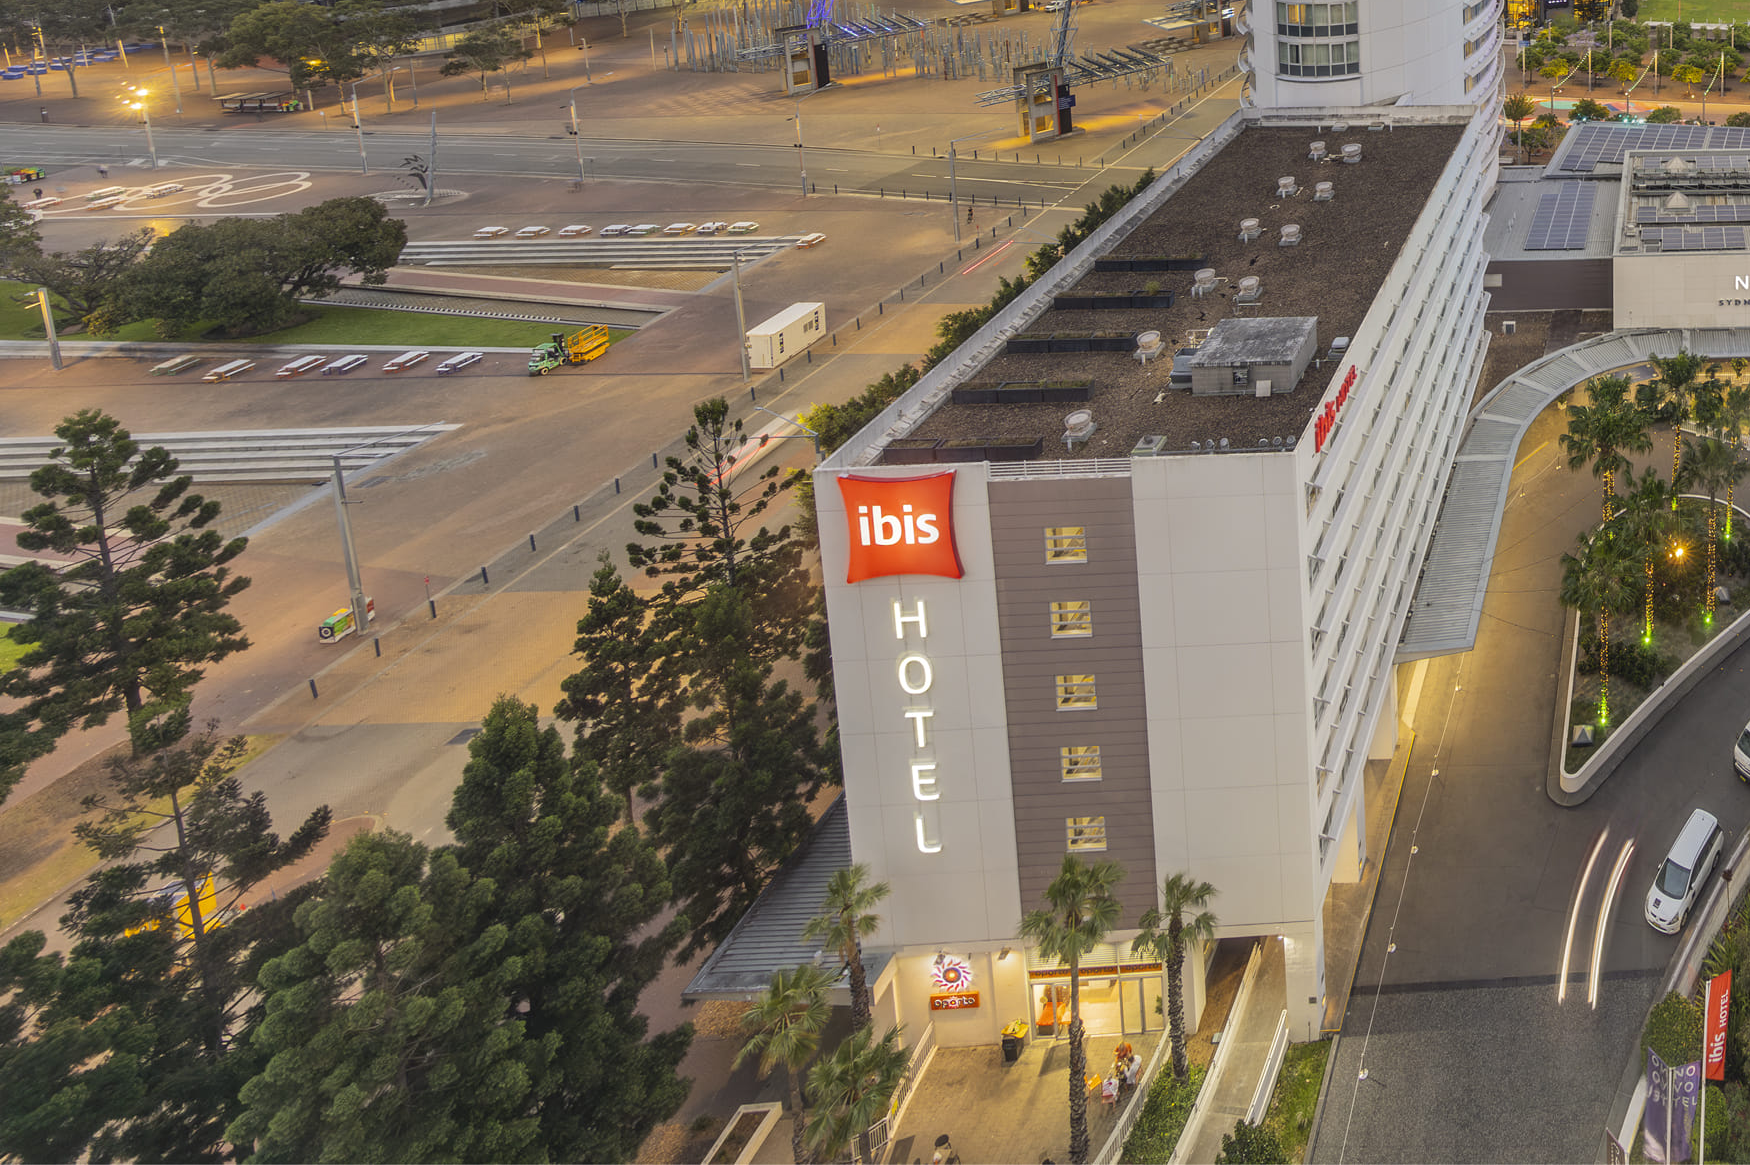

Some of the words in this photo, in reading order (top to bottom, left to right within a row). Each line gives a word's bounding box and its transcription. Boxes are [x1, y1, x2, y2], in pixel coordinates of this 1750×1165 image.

[1315, 401, 1336, 453] ibis
[858, 504, 940, 546] ibis
[892, 598, 943, 854] HOTEL
[934, 996, 975, 1008] oporto
[1708, 1032, 1726, 1063] ibis
[1720, 989, 1729, 1027] HOTEL
[1674, 1065, 1696, 1077] NO
[1674, 1081, 1694, 1093] VO
[1673, 1096, 1697, 1108] TEL
